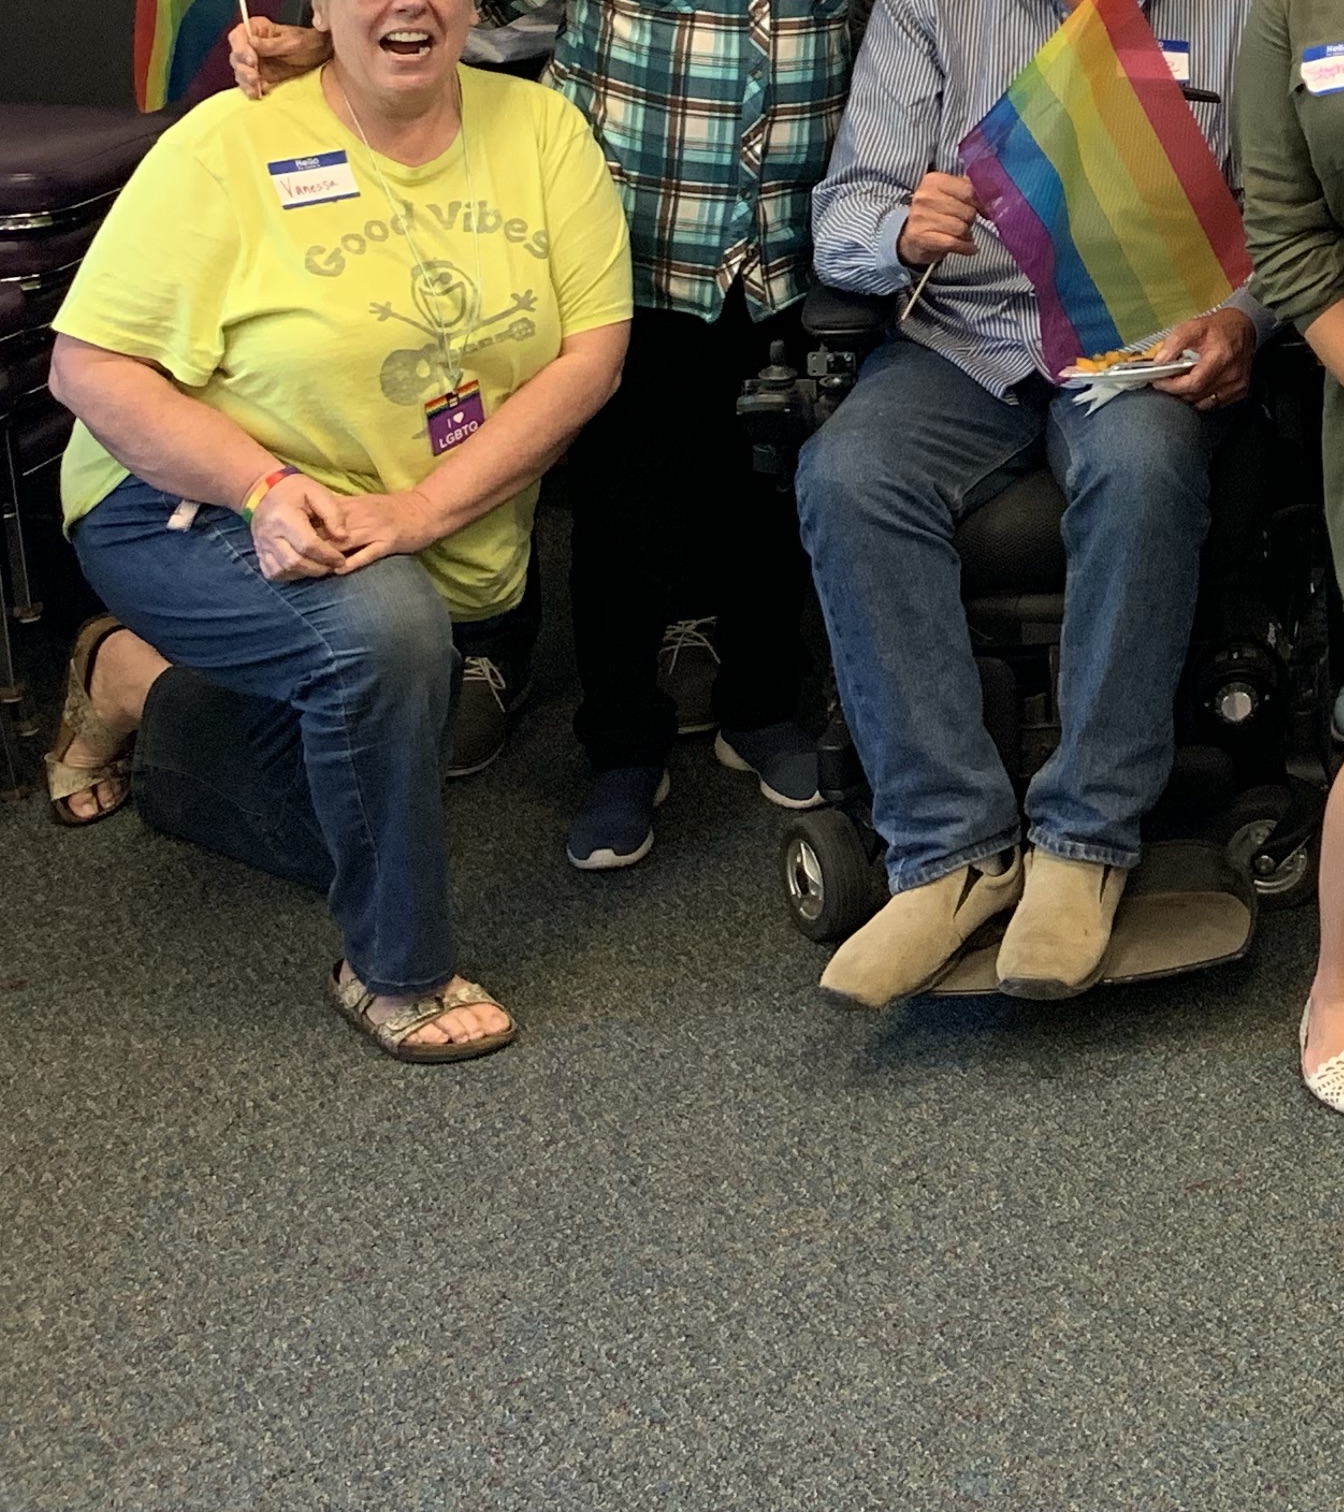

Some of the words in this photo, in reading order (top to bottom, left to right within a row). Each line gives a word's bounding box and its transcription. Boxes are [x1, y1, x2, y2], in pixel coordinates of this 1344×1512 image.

[279, 177, 338, 199] Vanessa
[305, 199, 414, 278] Good
[425, 199, 551, 260] Vibes
[439, 419, 480, 450] LGBTQ
